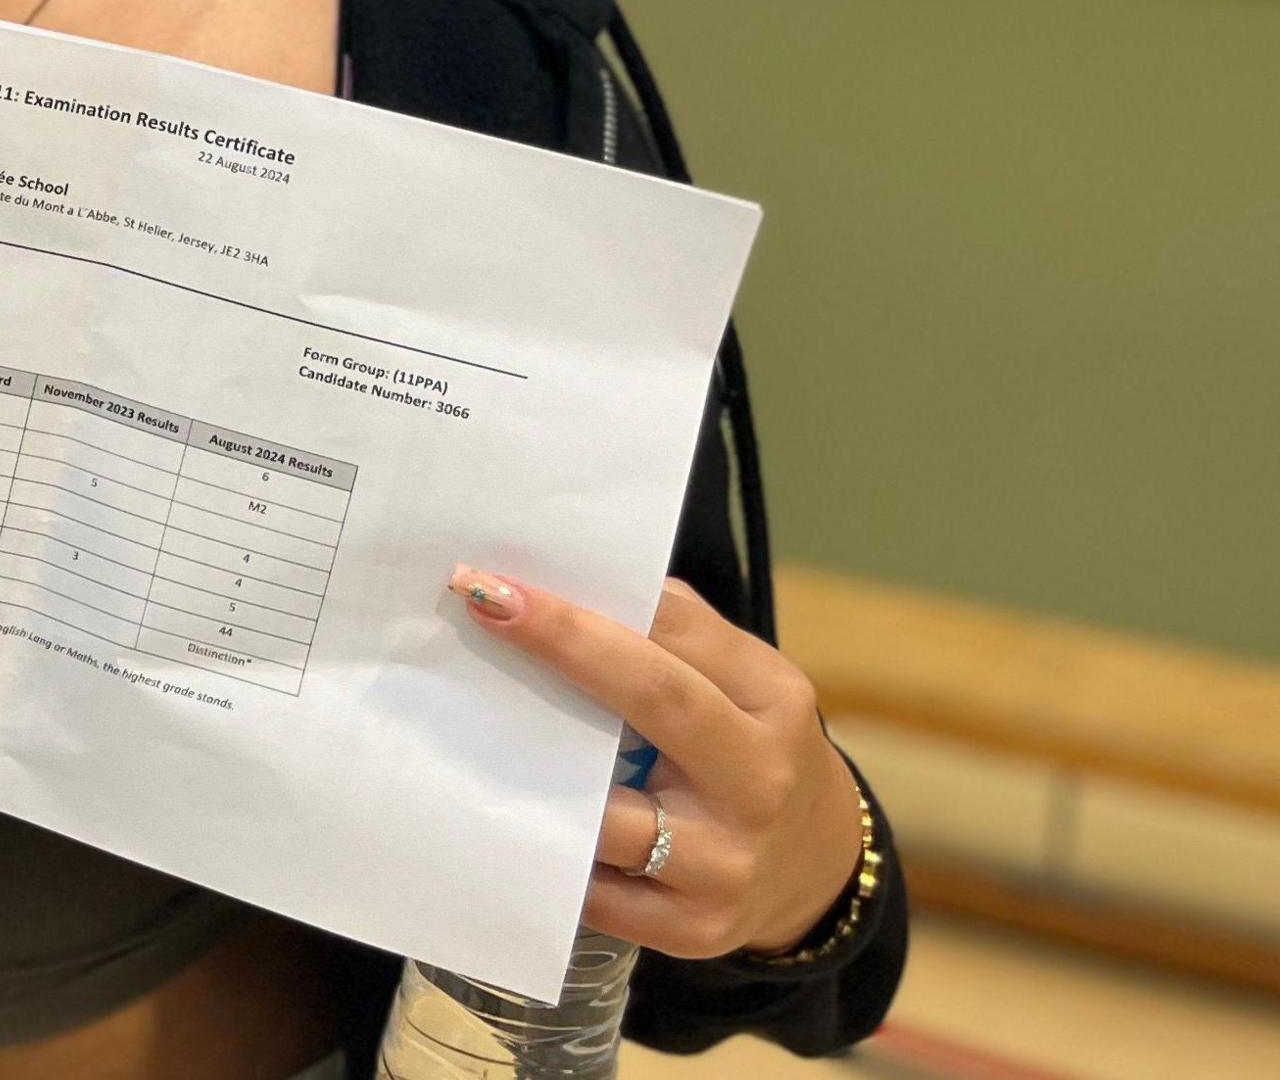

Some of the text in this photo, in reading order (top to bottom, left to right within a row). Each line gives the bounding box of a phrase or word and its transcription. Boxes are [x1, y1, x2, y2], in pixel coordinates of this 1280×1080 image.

[24, 91, 131, 123] Examination
[136, 112, 199, 141] Results
[204, 129, 295, 165] Certificate
[197, 151, 290, 184] 22 August 2024
[18, 175, 69, 196] School
[14, 195, 29, 207] du
[32, 199, 65, 215] Mont
[67, 208, 74, 216] a
[123, 216, 136, 229] St
[138, 220, 174, 242] Helier,
[178, 232, 218, 255] Jersey,
[220, 243, 241, 259] JE2
[243, 250, 269, 267] 3HA
[303, 347, 448, 396] Form Group: (11PPA)
[298, 365, 470, 420] Candidate Number: 3066
[43, 384, 180, 434] November 2023 Results
[209, 434, 333, 478] August 2024 Results
[91, 478, 98, 488] 5
[261, 472, 269, 482] 6
[248, 501, 267, 515] M2
[73, 551, 79, 561] 3
[242, 554, 250, 564] 4
[235, 578, 242, 588] 4
[229, 602, 236, 612] 5
[219, 626, 233, 637] 44
[28, 631, 52, 651] Lang
[54, 644, 65, 652] or
[66, 647, 100, 670] Maths,
[102, 662, 119, 676] the
[121, 667, 161, 691] highest
[163, 683, 194, 700] grade
[197, 691, 234, 711] stands.
